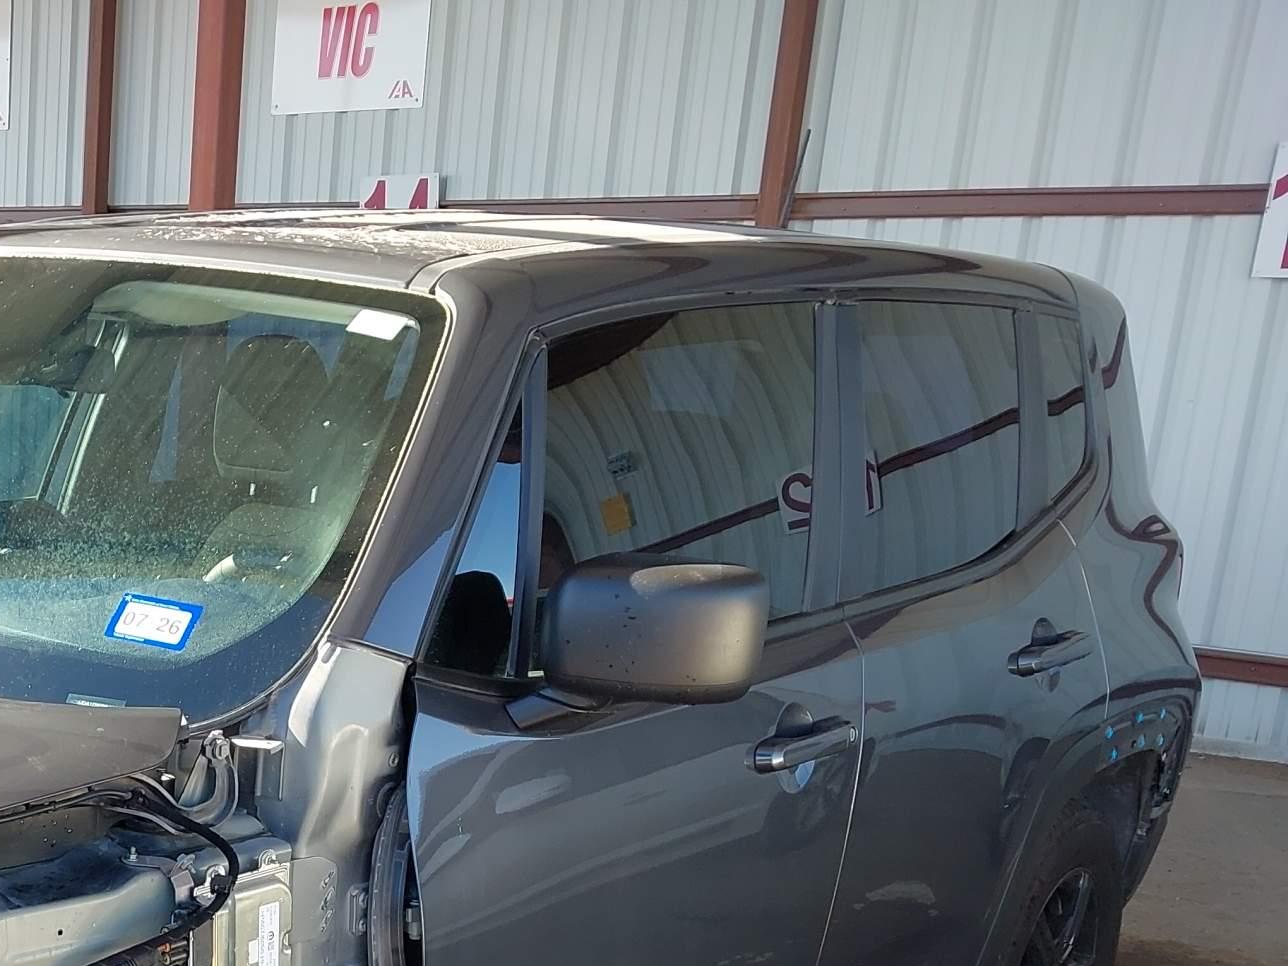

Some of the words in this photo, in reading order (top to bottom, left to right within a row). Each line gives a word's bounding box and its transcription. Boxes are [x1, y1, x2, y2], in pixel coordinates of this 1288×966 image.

[318, 2, 380, 78] VIC
[123, 611, 149, 627] 07
[156, 617, 183, 635] 26
